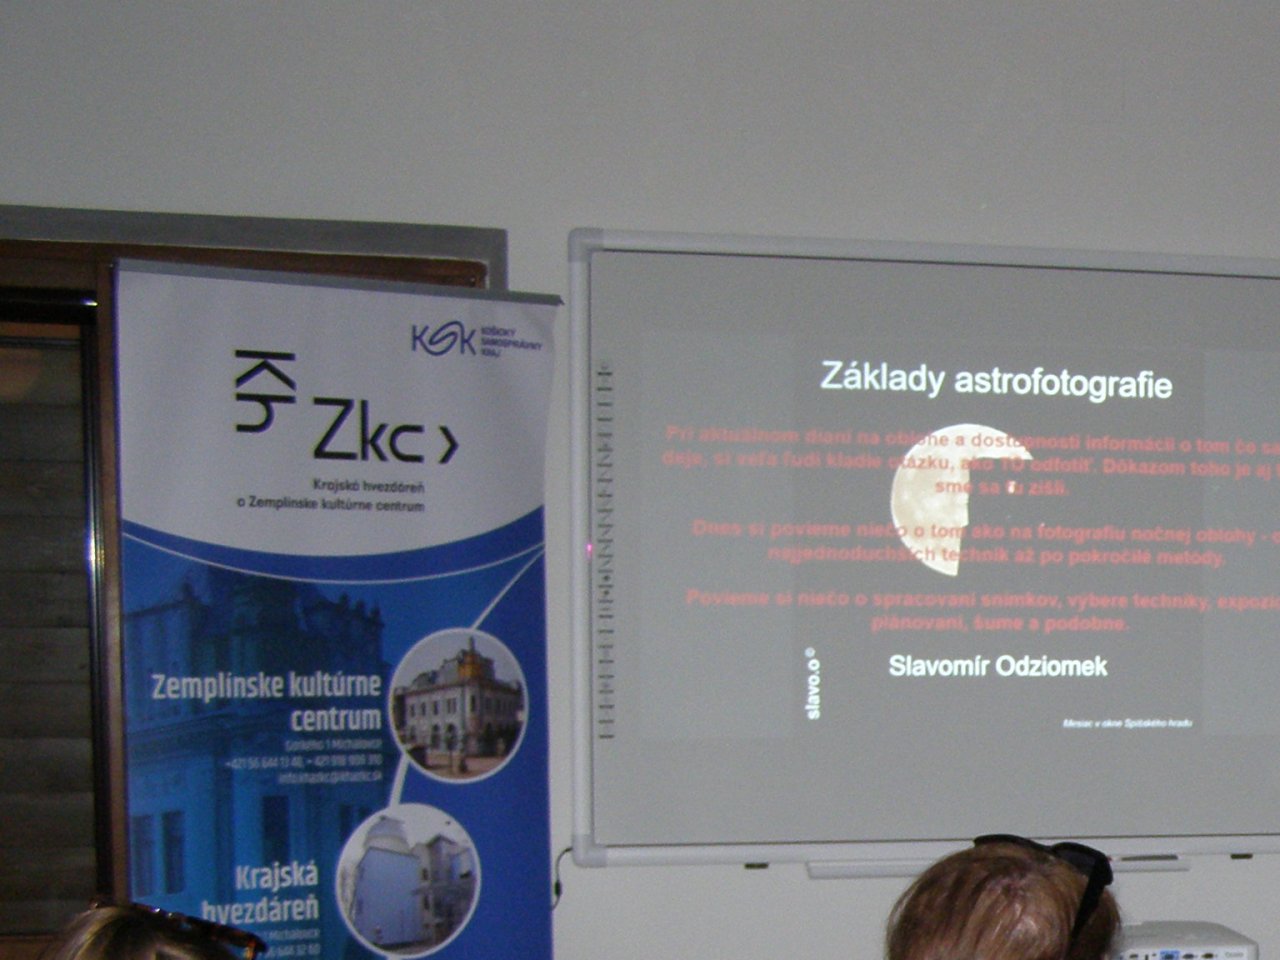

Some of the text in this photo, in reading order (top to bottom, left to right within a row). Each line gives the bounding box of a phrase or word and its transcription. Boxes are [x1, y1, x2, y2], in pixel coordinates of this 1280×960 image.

[412, 321, 476, 356] KSK
[820, 361, 1173, 403] Základy astrofotografie
[955, 434, 965, 446] a
[1180, 439, 1192, 453] o
[935, 480, 973, 494] sme
[978, 481, 1000, 495] sa
[376, 501, 425, 513] centrum
[914, 526, 925, 538] o
[930, 524, 967, 539] tom
[855, 593, 868, 606] o
[889, 654, 1109, 677] Slavomír Odziomek
[152, 670, 382, 702] Zemplínske kultúrne
[290, 707, 382, 732] centrum
[235, 860, 319, 892] Krajská
[202, 894, 320, 925] hvezdáreň
